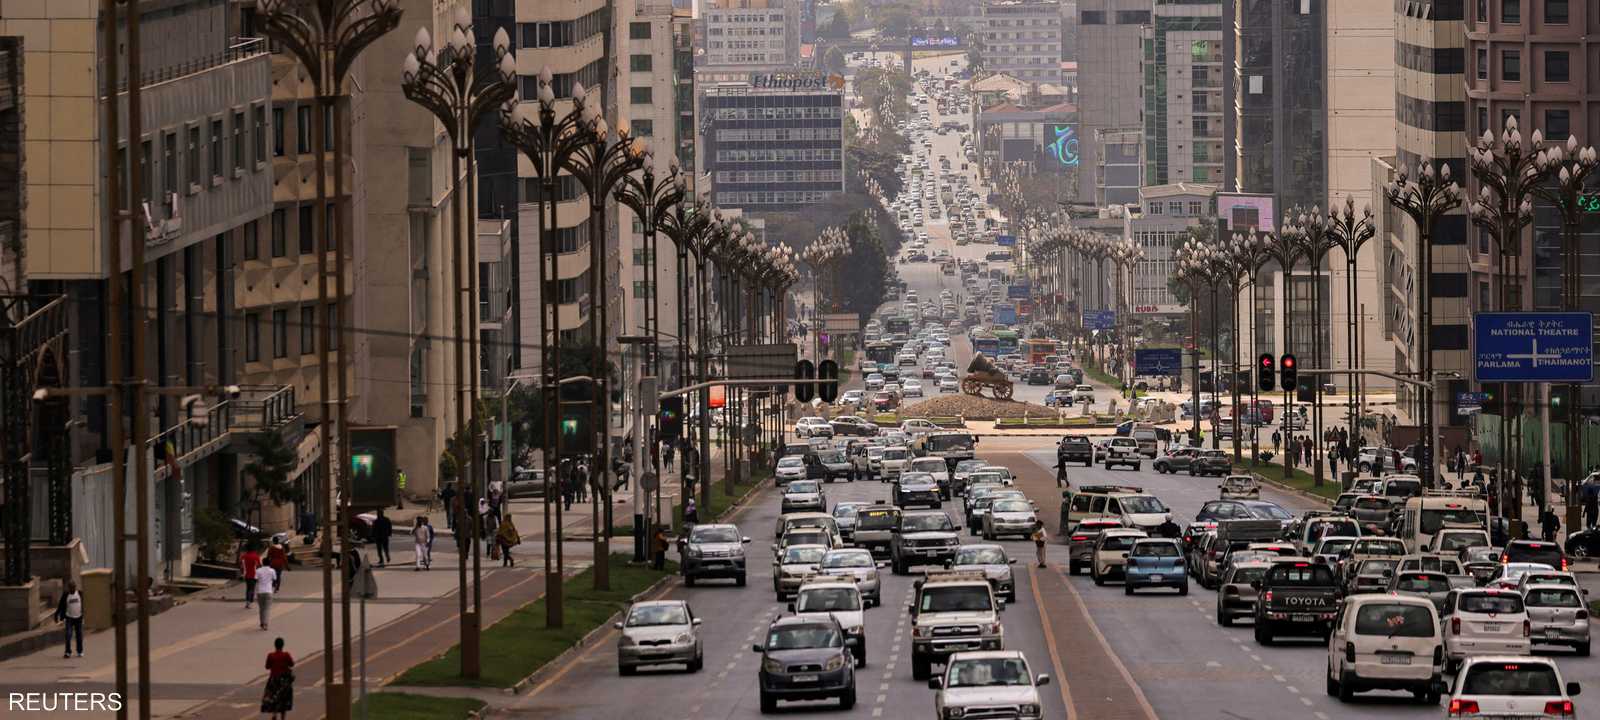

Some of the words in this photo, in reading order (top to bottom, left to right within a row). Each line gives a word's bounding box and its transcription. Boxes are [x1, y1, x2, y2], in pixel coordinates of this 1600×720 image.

[754, 74, 828, 92] Ethiopost
[1491, 328, 1535, 336] NATIONAL
[1538, 328, 1579, 336] THEATRE
[1285, 597, 1326, 607] TOYOTA
